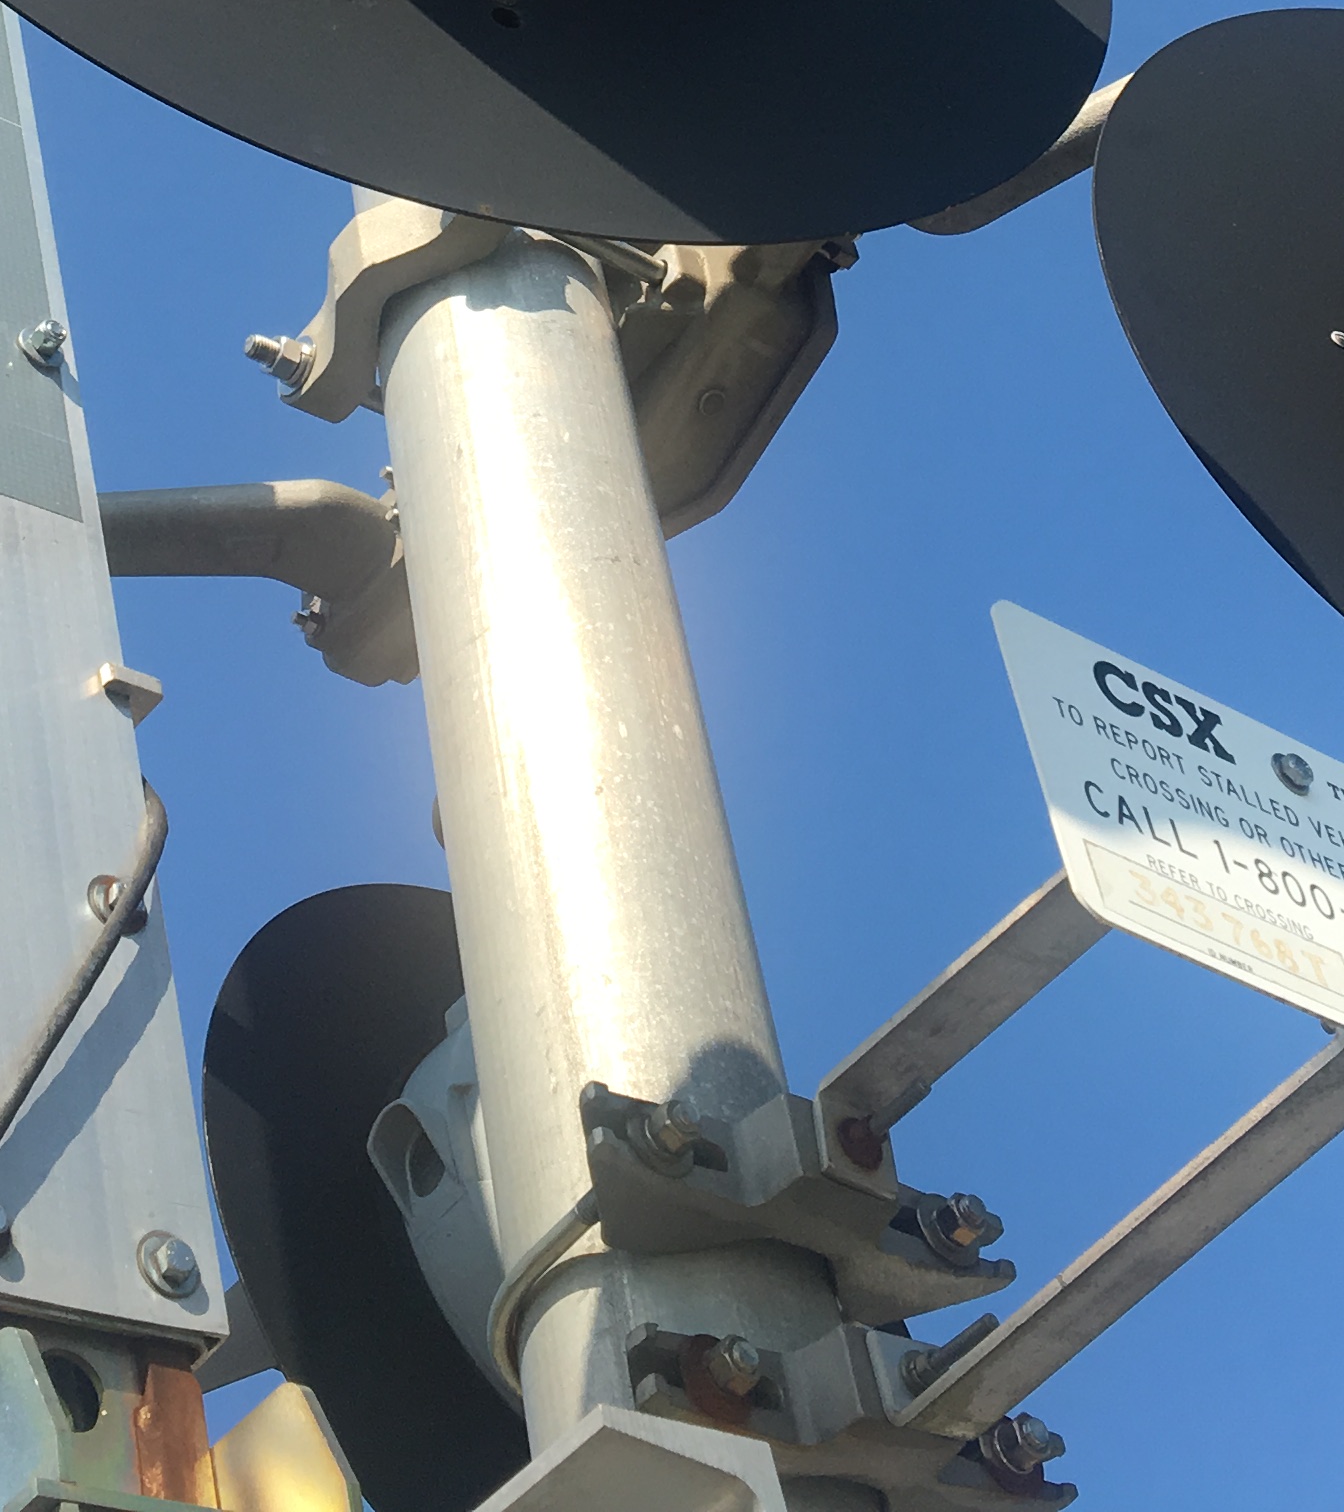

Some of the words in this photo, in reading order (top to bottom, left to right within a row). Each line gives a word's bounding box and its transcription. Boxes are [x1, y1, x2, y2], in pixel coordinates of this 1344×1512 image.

[1093, 661, 1236, 765] CSX
[1052, 696, 1084, 727] TO
[1093, 715, 1185, 775] REPORT
[1197, 765, 1300, 827] STALLED
[1110, 757, 1230, 828] CROSSING
[1239, 817, 1271, 848] OR
[1084, 780, 1199, 859] CALL
[1146, 854, 1201, 889] REFER
[1206, 883, 1228, 902] TO
[1234, 894, 1314, 941] CROSSING
